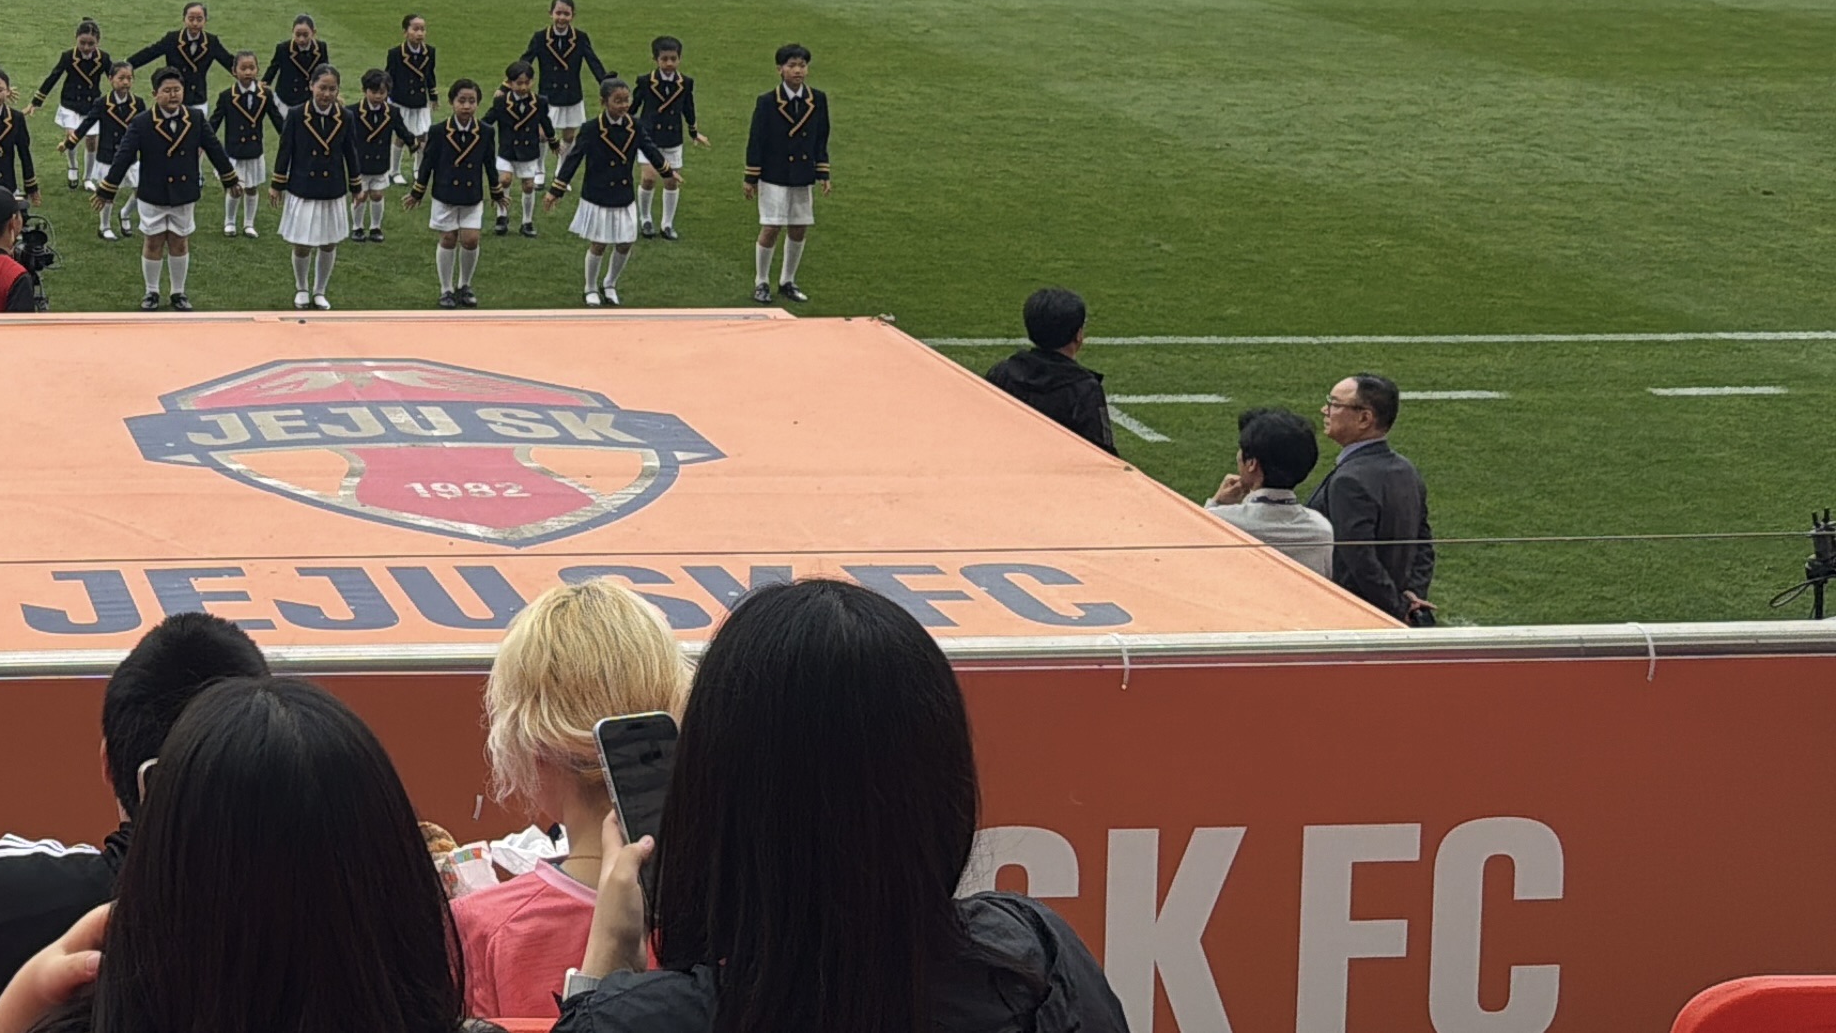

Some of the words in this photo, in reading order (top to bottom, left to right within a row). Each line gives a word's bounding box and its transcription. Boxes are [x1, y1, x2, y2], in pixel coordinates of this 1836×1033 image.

[187, 406, 462, 446] JEJU
[475, 408, 647, 443] SK
[404, 481, 532, 499] 1982
[21, 565, 534, 634] JEJU
[839, 563, 1134, 628] FC
[1296, 816, 1564, 1033] FC
